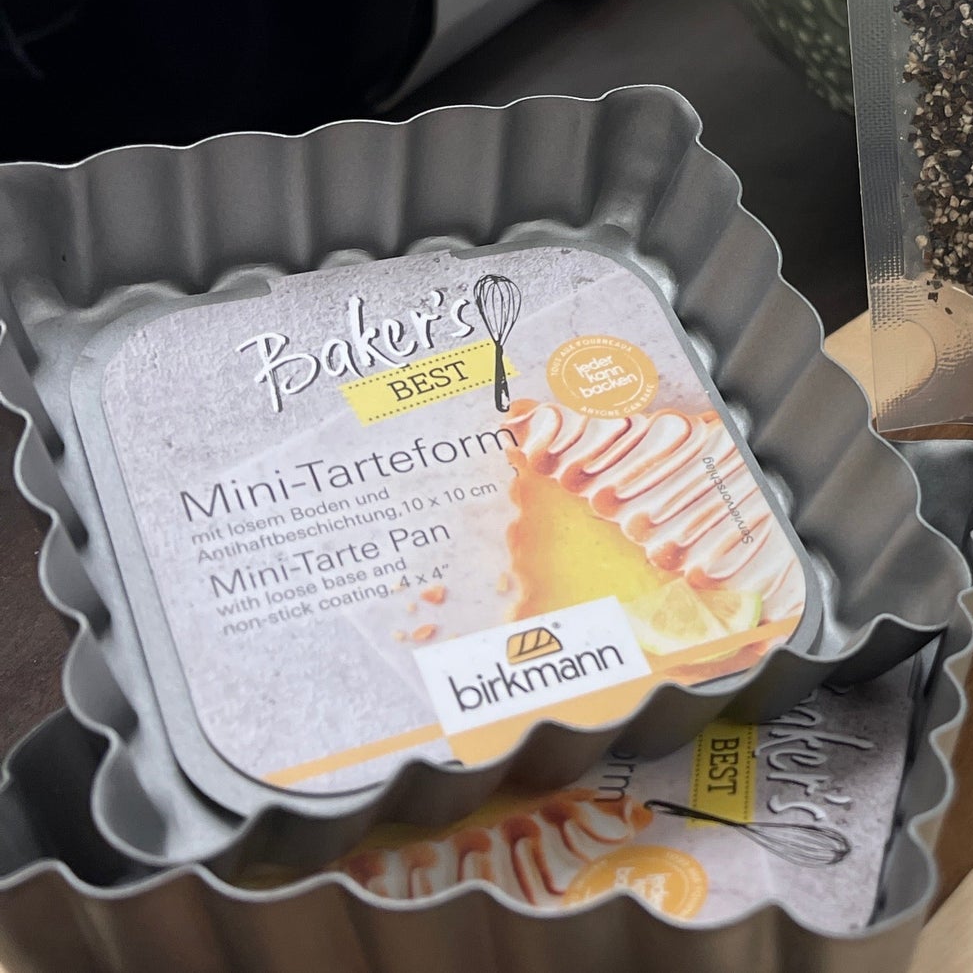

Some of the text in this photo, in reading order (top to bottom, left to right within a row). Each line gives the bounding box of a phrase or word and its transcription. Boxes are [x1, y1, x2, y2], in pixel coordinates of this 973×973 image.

[235, 287, 476, 414] Baker's
[573, 355, 614, 379] jeder
[584, 365, 625, 384] kann
[386, 360, 470, 403] BEST
[578, 372, 639, 399] backen
[180, 427, 520, 523] Mini-Tarteform
[429, 495, 442, 509] x
[443, 486, 466, 504] 10
[469, 481, 499, 498] cm
[702, 456, 755, 545] Serviervorschlag
[191, 487, 391, 546] mit losem Boden und
[209, 522, 452, 598] Mini-Tarte Pan
[216, 557, 407, 617] with loose base and
[222, 598, 313, 636] non-stick
[398, 576, 412, 590] 4
[416, 573, 428, 585] x
[448, 644, 625, 713] birkmann
[707, 736, 741, 796] BEST
